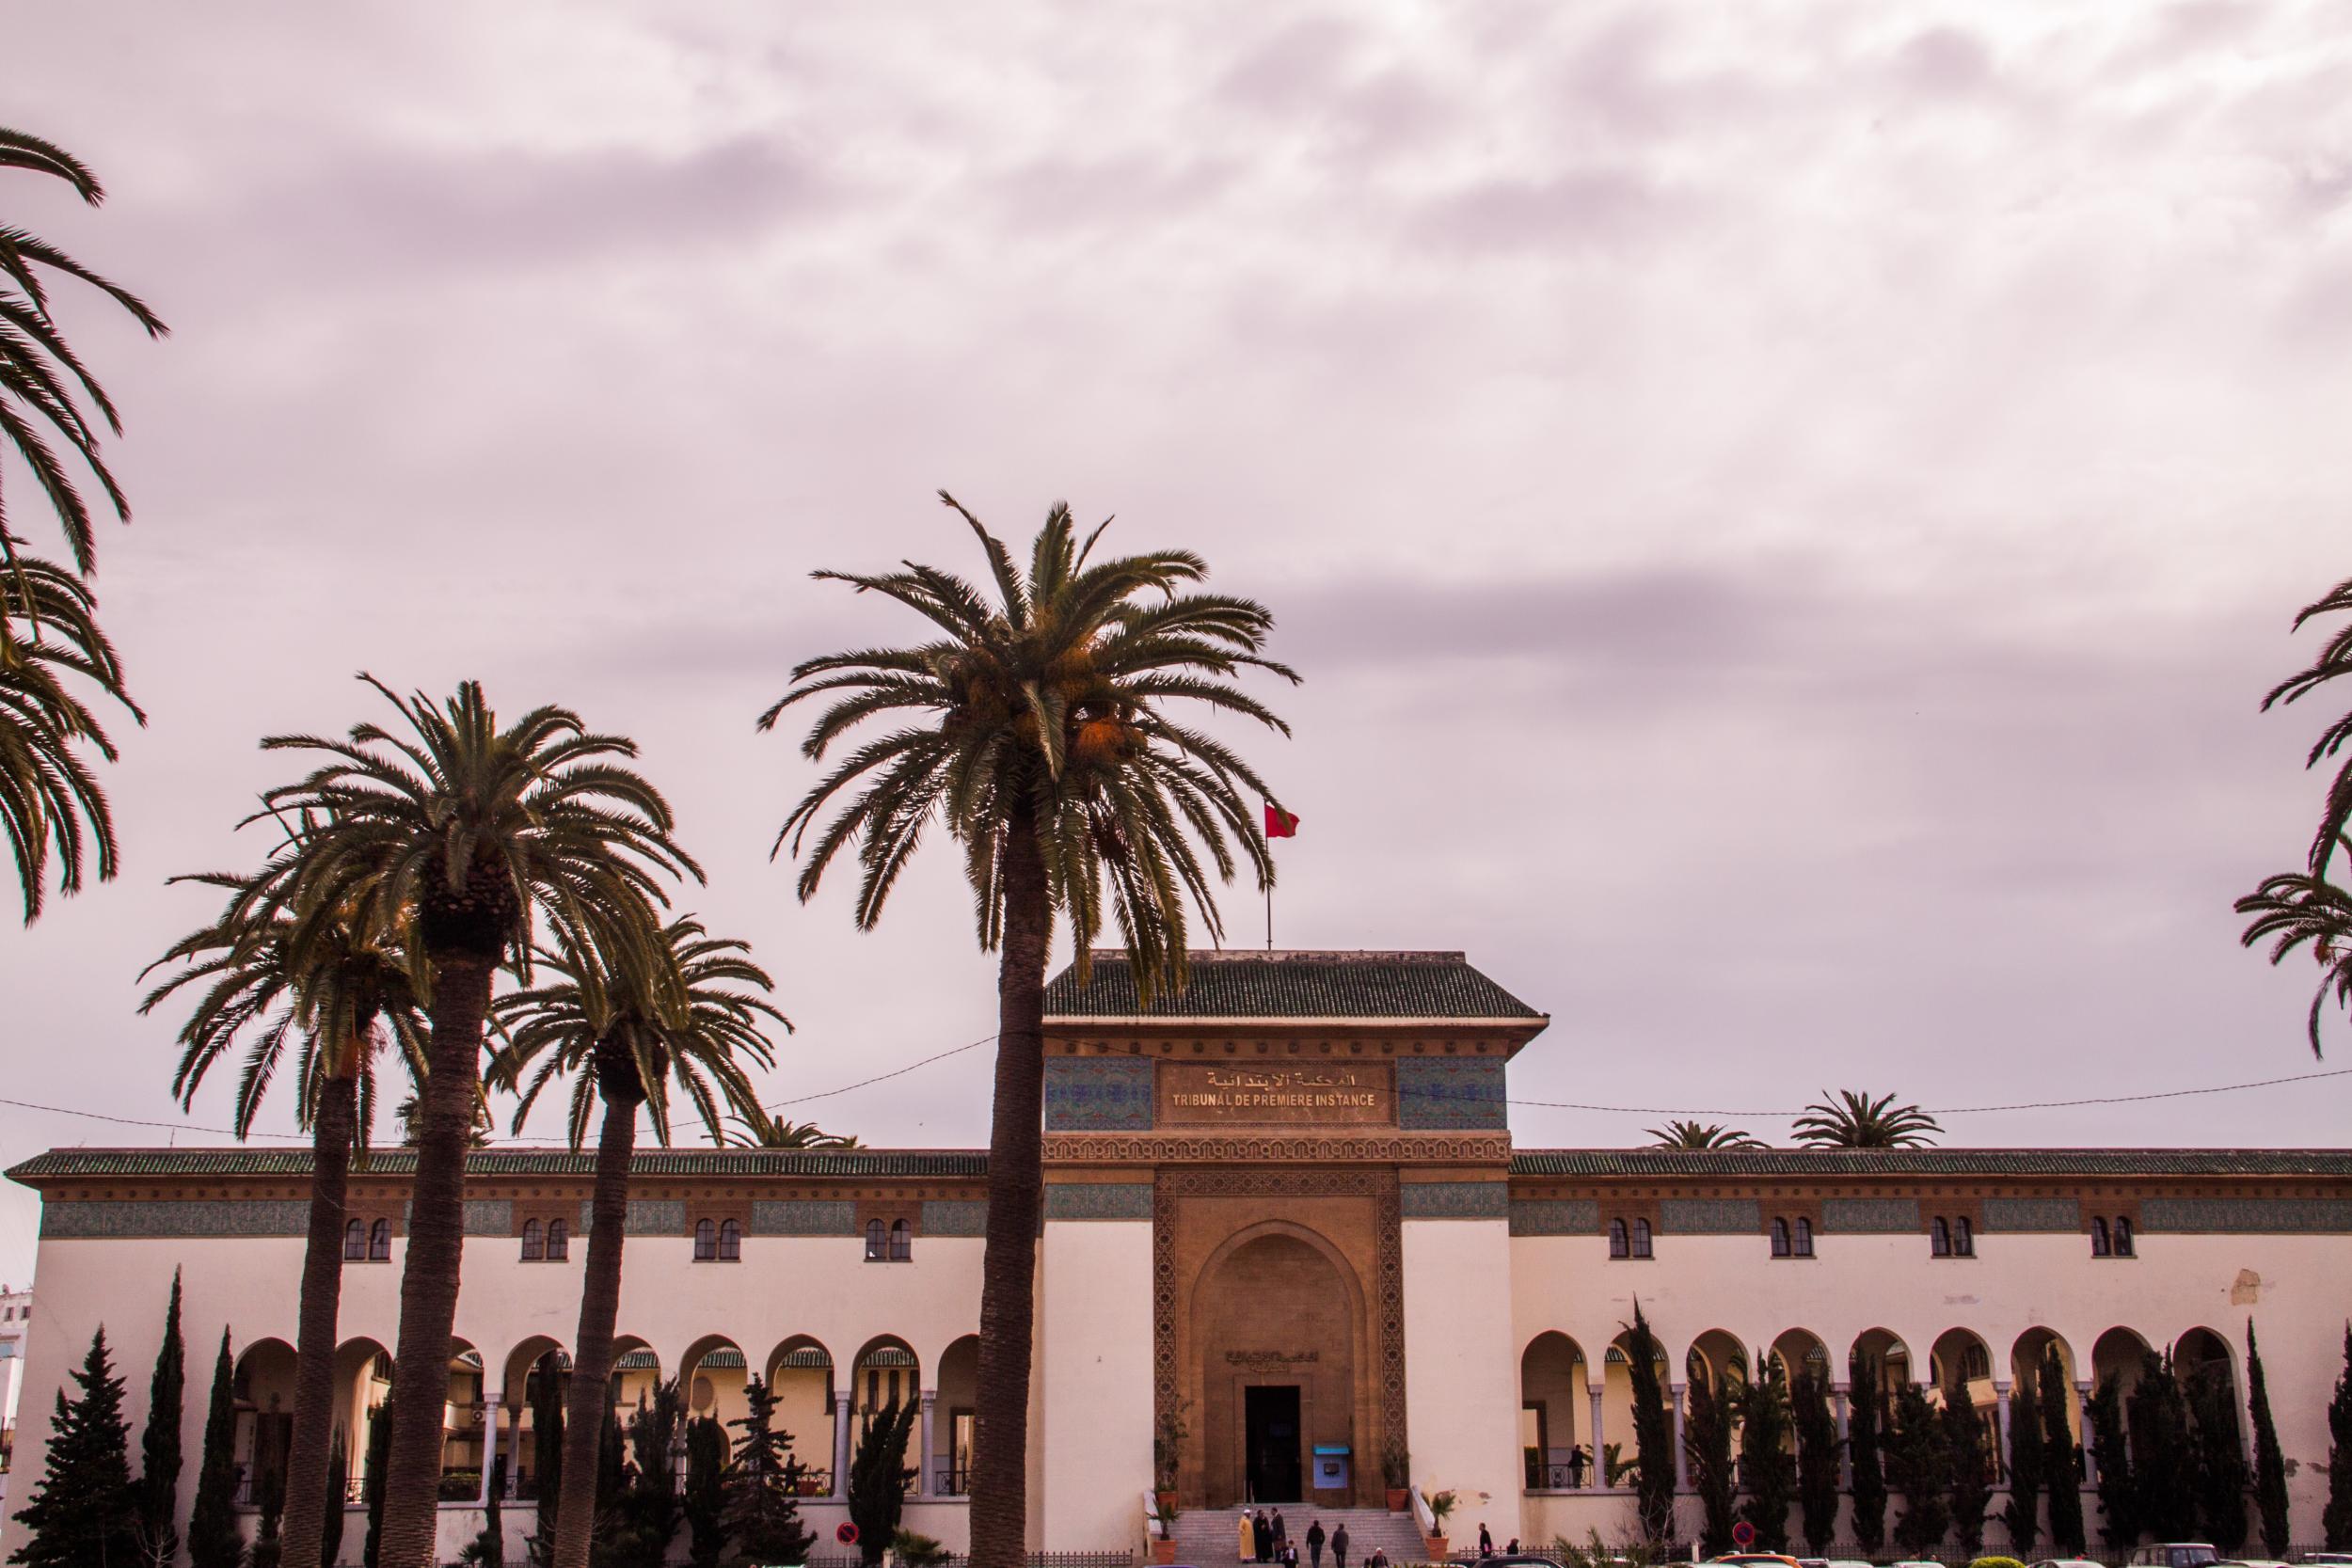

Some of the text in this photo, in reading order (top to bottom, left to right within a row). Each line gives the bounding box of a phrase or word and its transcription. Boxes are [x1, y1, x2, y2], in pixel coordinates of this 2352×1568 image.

[1173, 1094, 1375, 1106] TRIBUNAL DE PREMIERE INSTANCE
